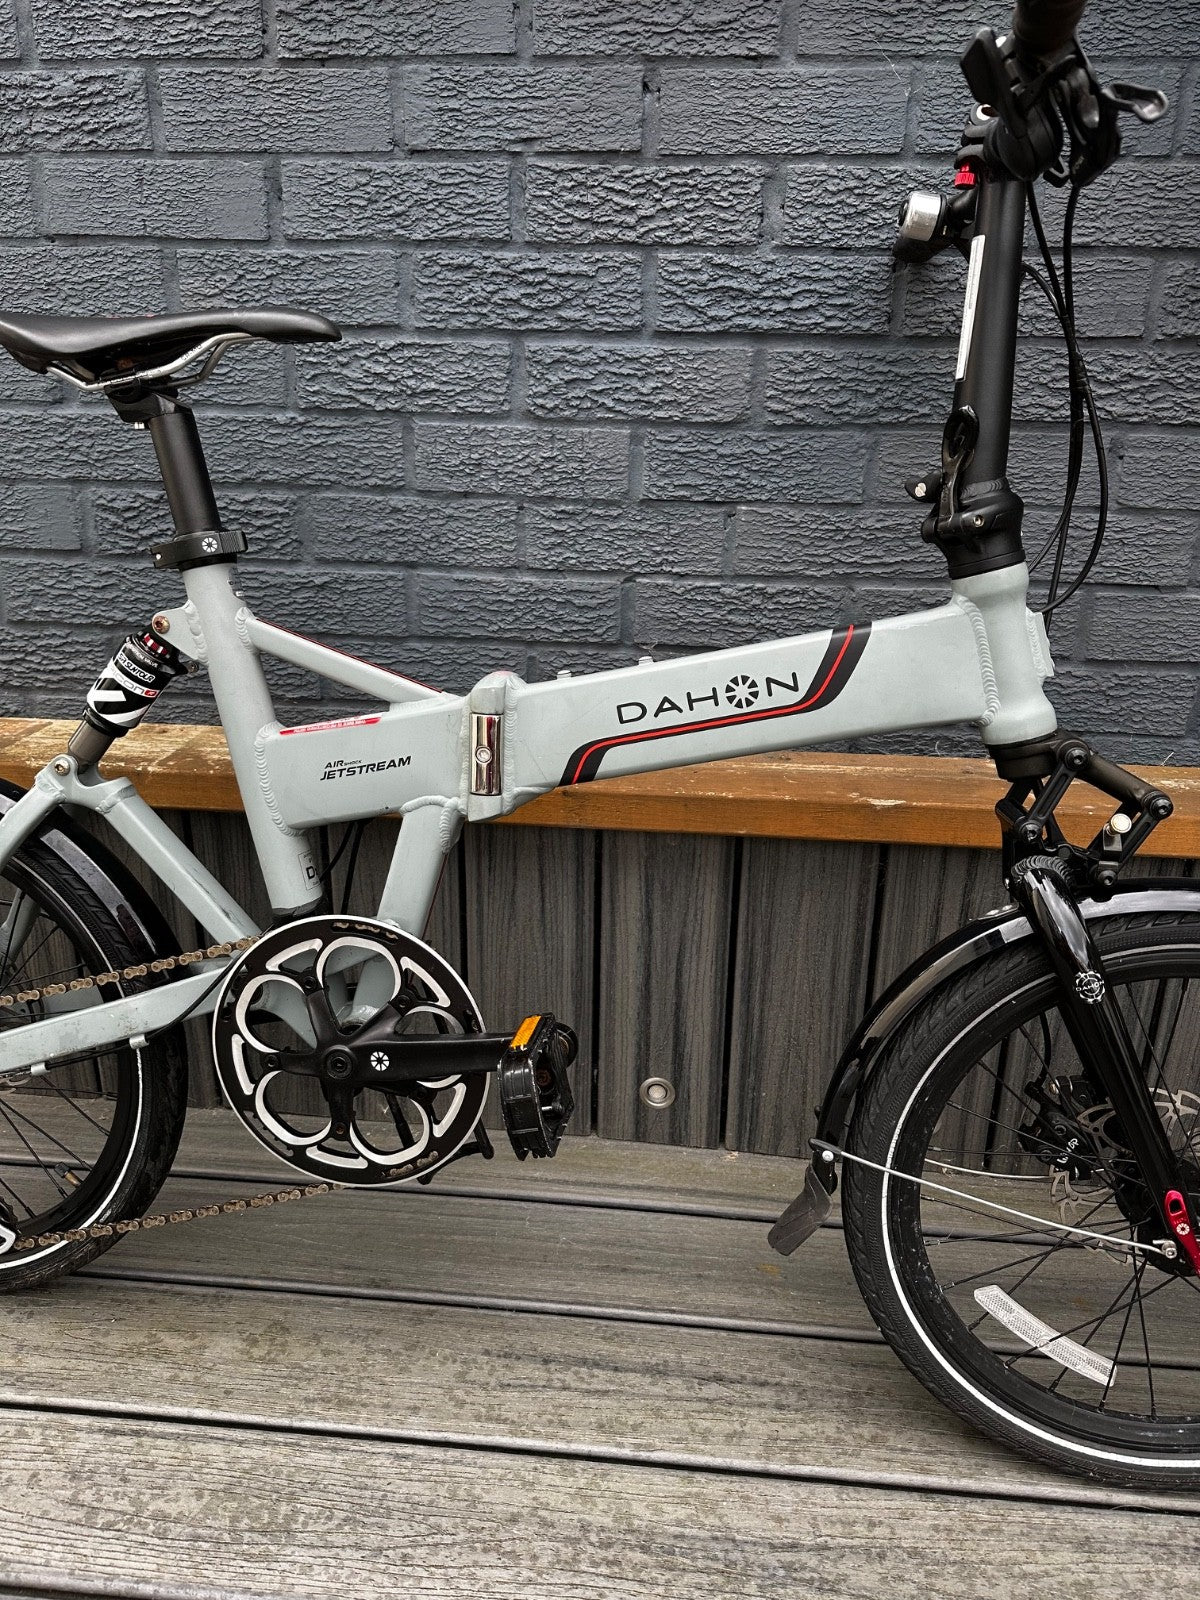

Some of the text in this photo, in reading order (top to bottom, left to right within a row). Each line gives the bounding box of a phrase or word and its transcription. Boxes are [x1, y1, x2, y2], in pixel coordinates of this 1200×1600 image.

[125, 661, 155, 682] SUNTOUR
[616, 672, 800, 725] DAHON
[320, 755, 411, 781] JETSTREAM
[325, 760, 344, 769] AIR
[1075, 979, 1105, 992] DAHON
